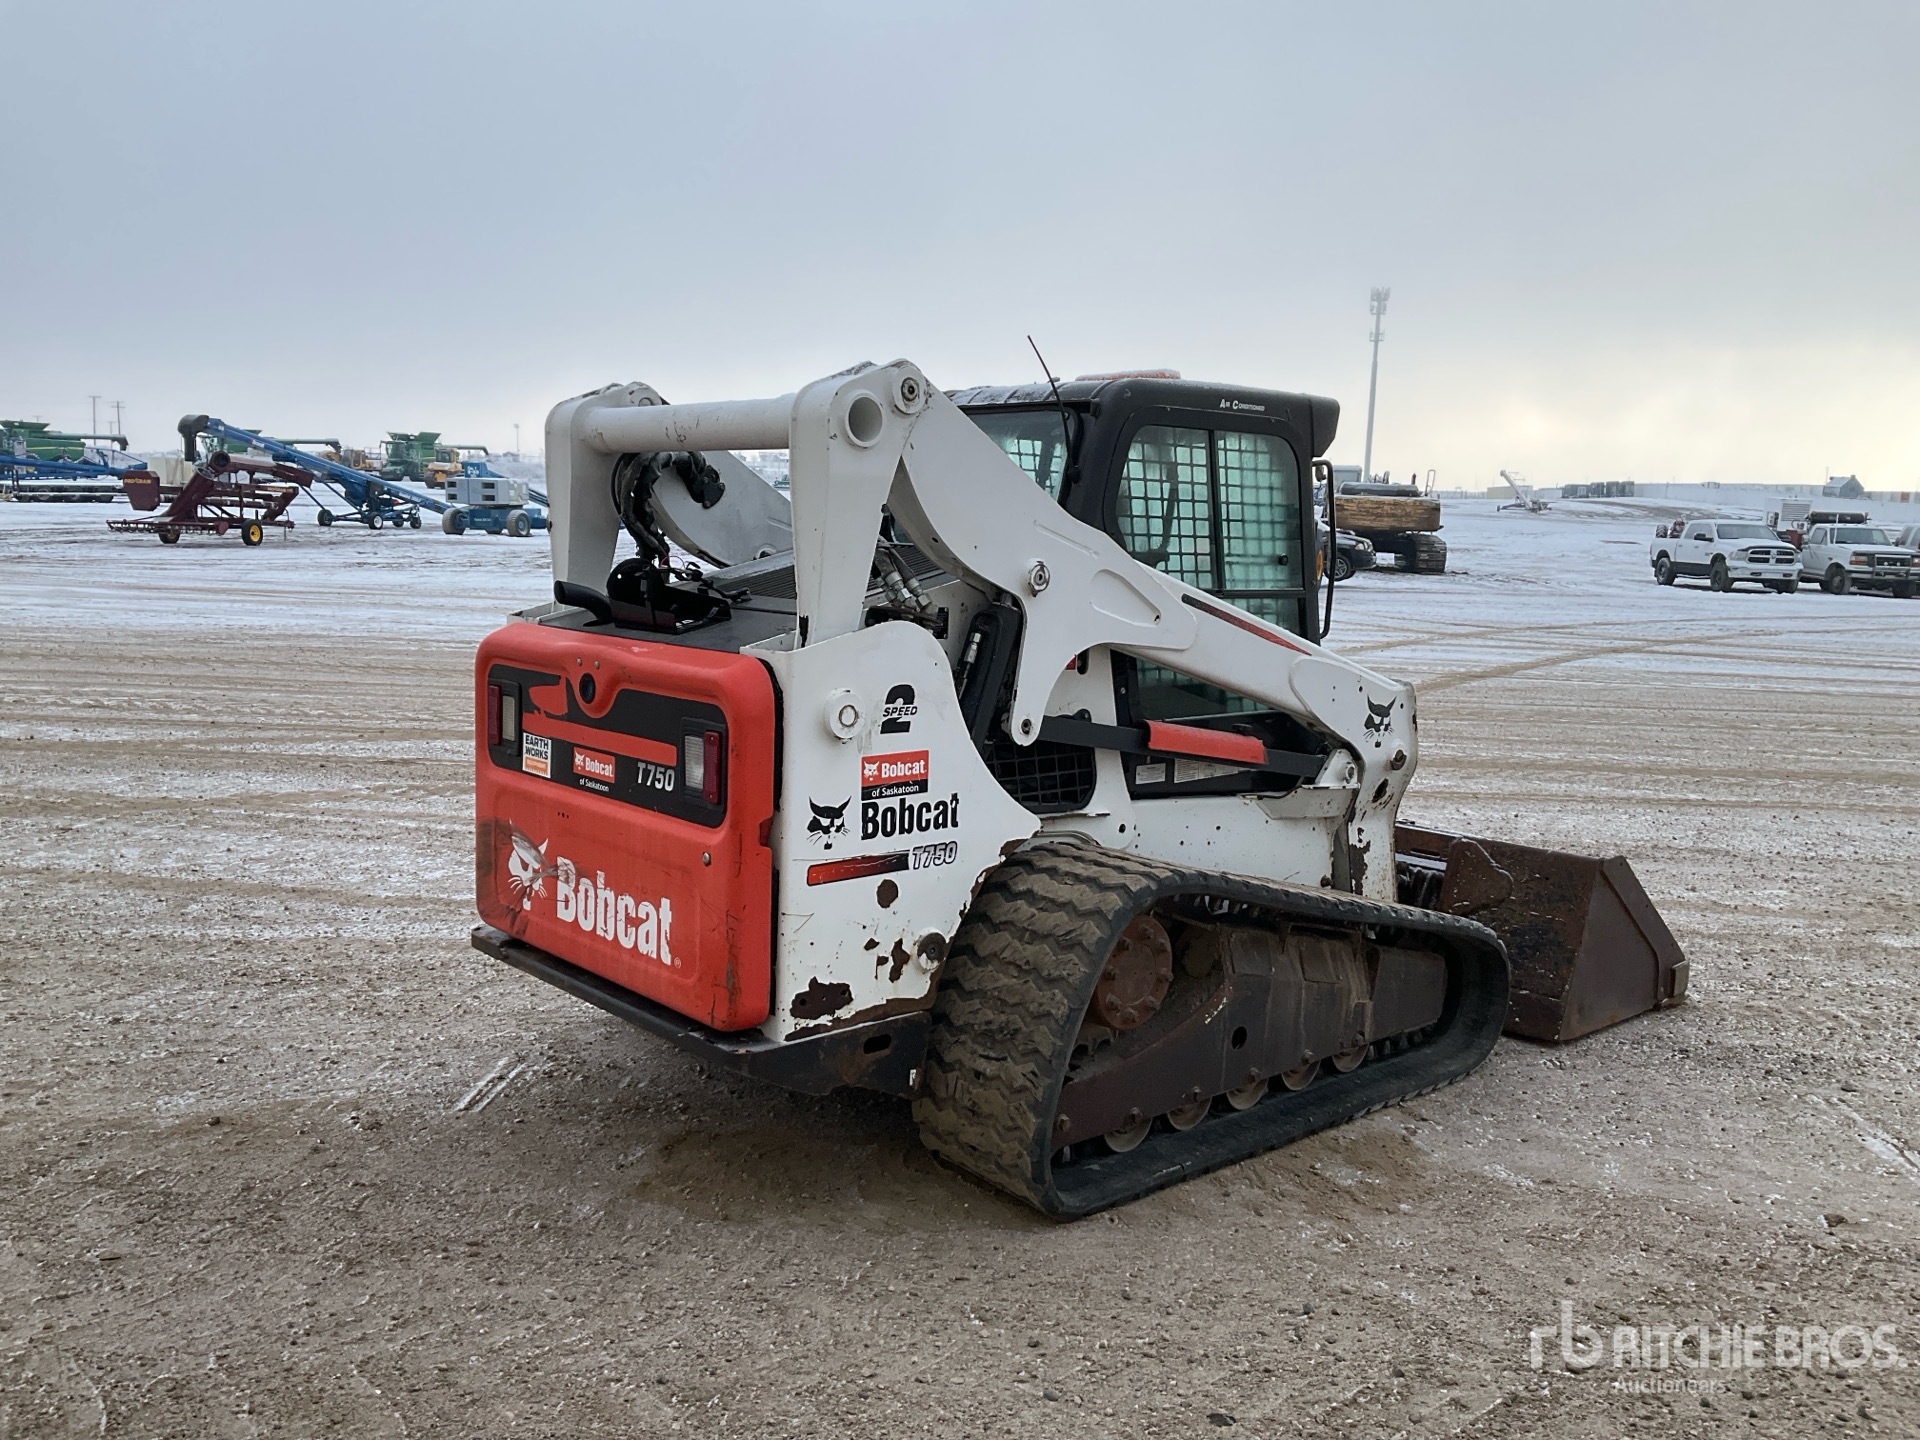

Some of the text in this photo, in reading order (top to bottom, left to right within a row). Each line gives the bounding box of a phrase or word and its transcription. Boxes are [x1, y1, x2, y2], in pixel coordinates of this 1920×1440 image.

[882, 705, 918, 717] SPEED
[525, 734, 549, 750] EARTH
[525, 745, 549, 760] WORKS
[585, 757, 614, 777] Bobcat
[637, 761, 675, 792] T750
[881, 759, 925, 779] Bobcat
[579, 778, 610, 793] of Saskatoon
[871, 784, 919, 797] of Saskatoon
[861, 792, 960, 841] Bobcat
[911, 841, 958, 870] T750
[556, 855, 672, 966] Bobcat
